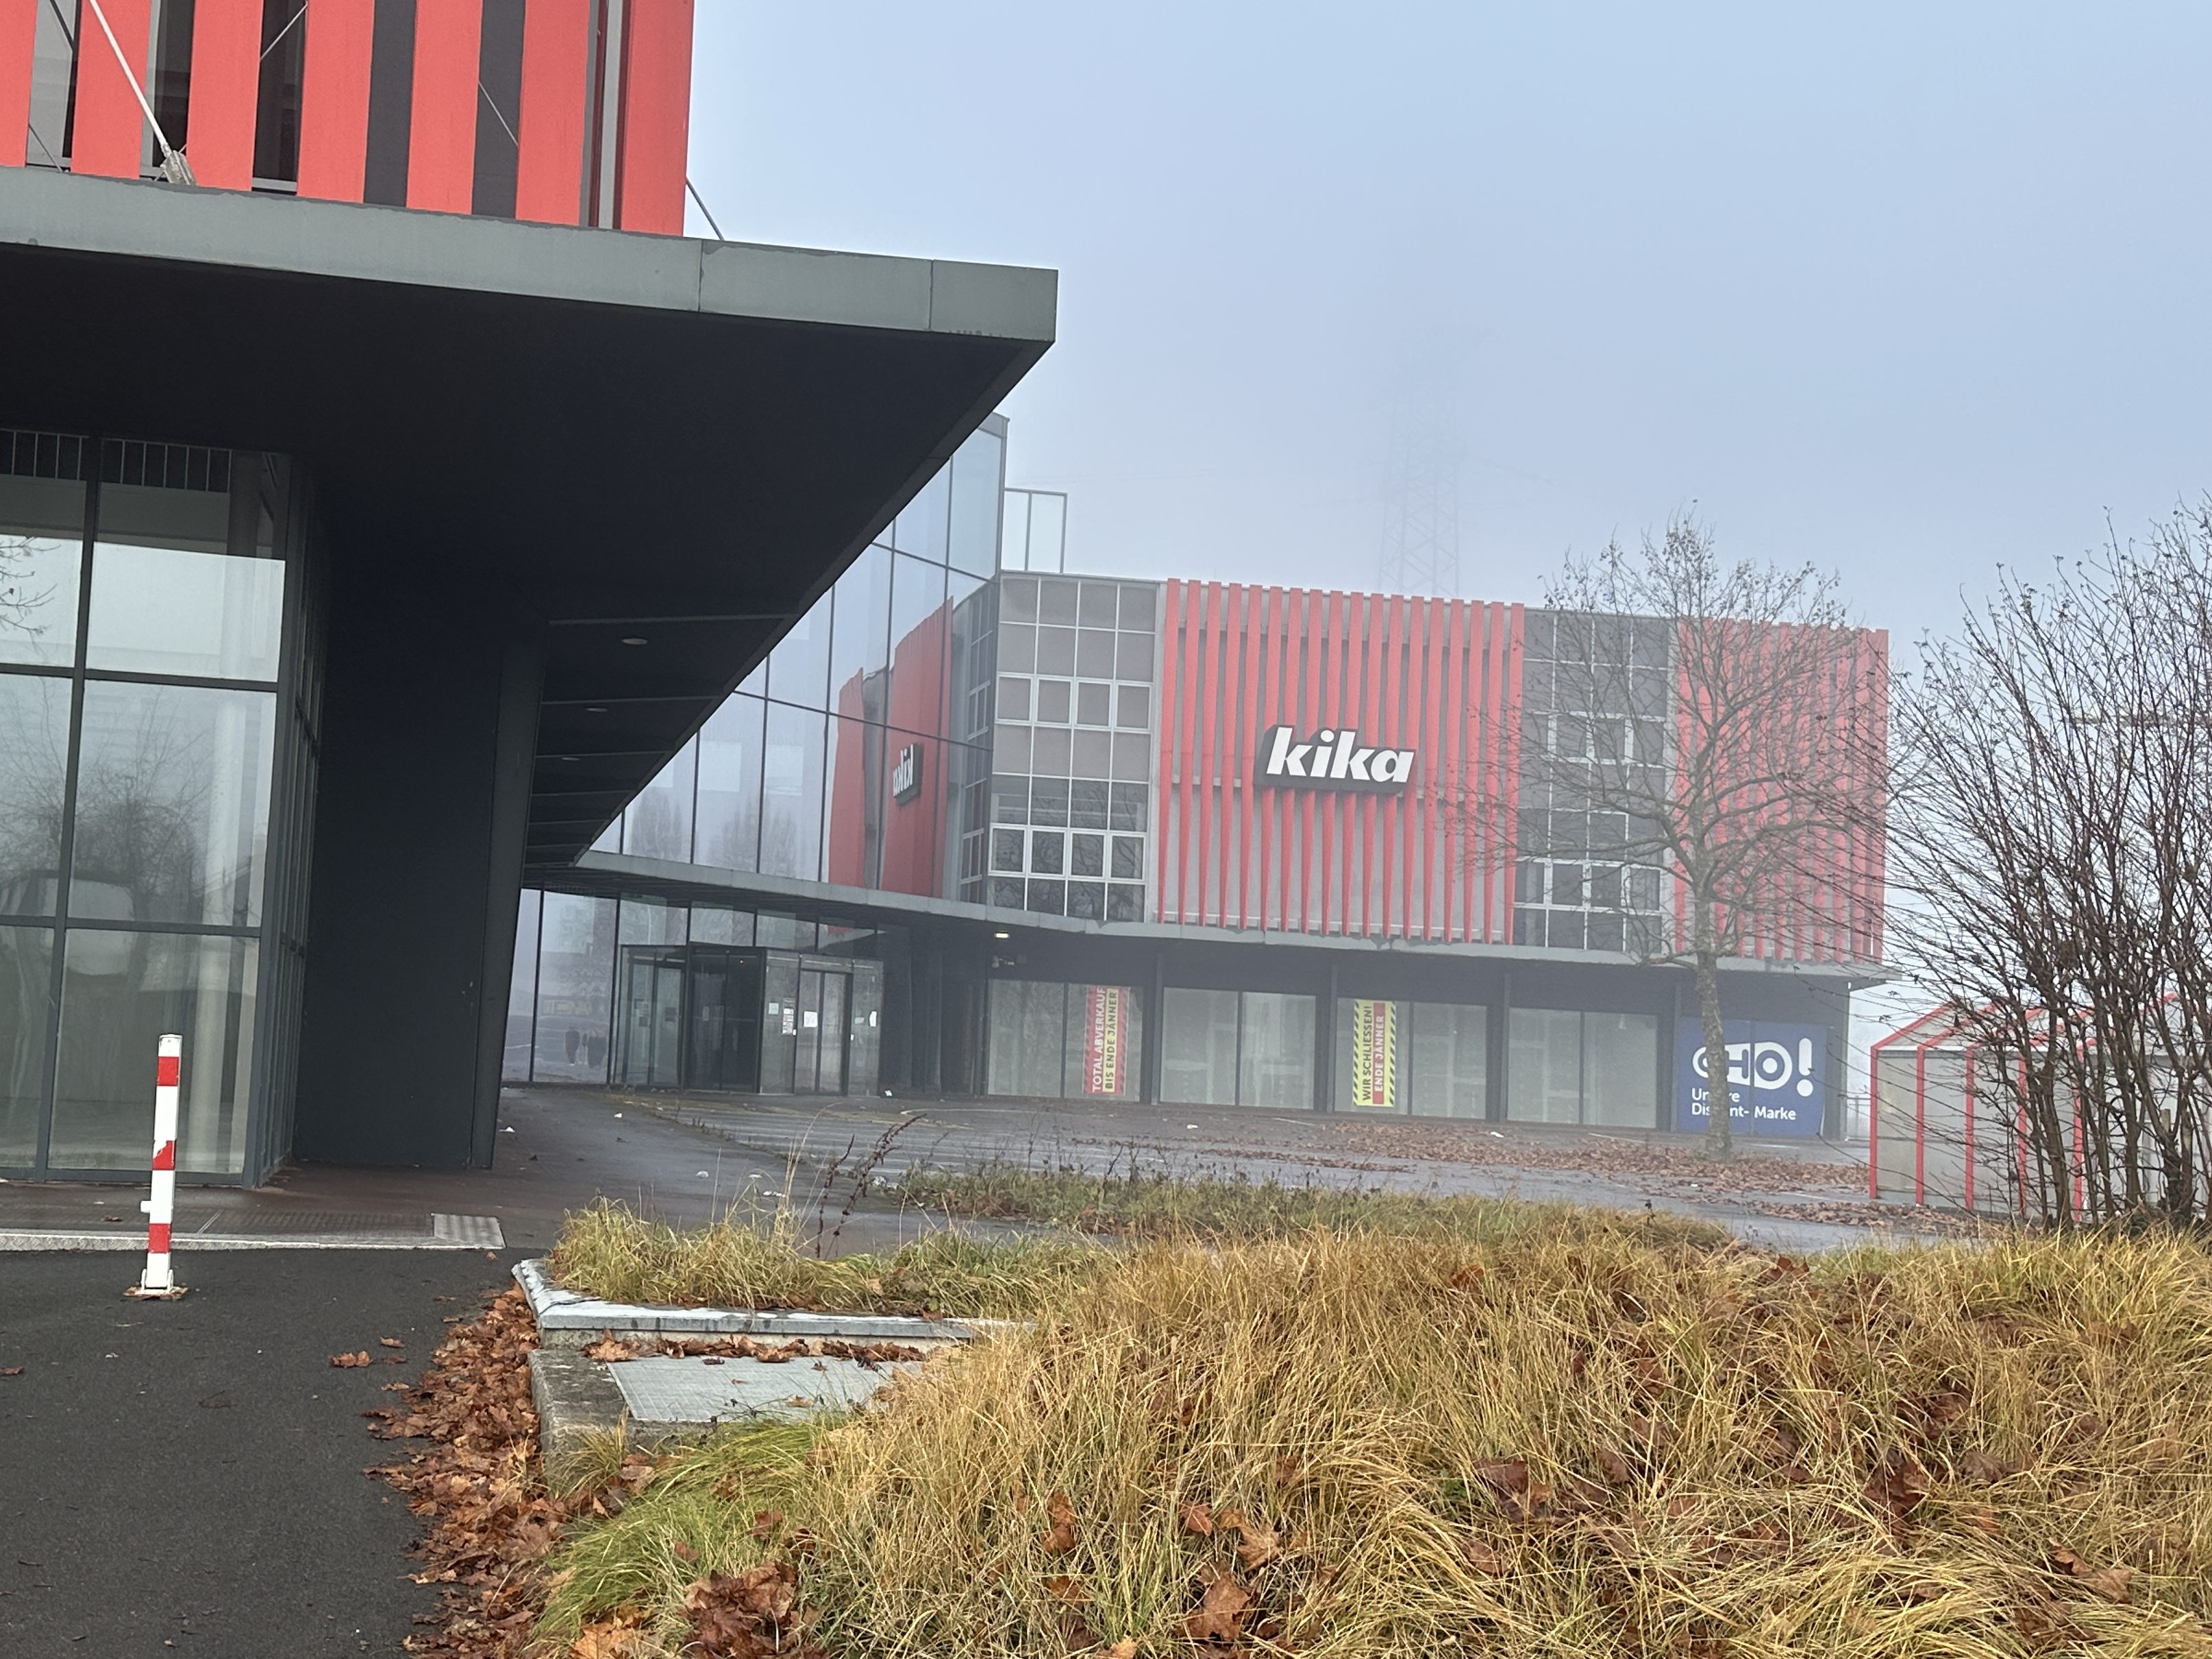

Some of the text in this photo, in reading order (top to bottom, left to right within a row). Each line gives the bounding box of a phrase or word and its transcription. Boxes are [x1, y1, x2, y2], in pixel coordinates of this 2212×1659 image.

[1266, 727, 1415, 783] kika
[1092, 987, 1106, 1093] TOTAL ABVERKAUF
[1105, 992, 1117, 1089] BIS ENDE JÄNNER
[1363, 1006, 1372, 1101] WIR SCHLIESSEN!
[1374, 1062, 1383, 1092] ENDE
[1754, 1106, 1796, 1120] Marke
